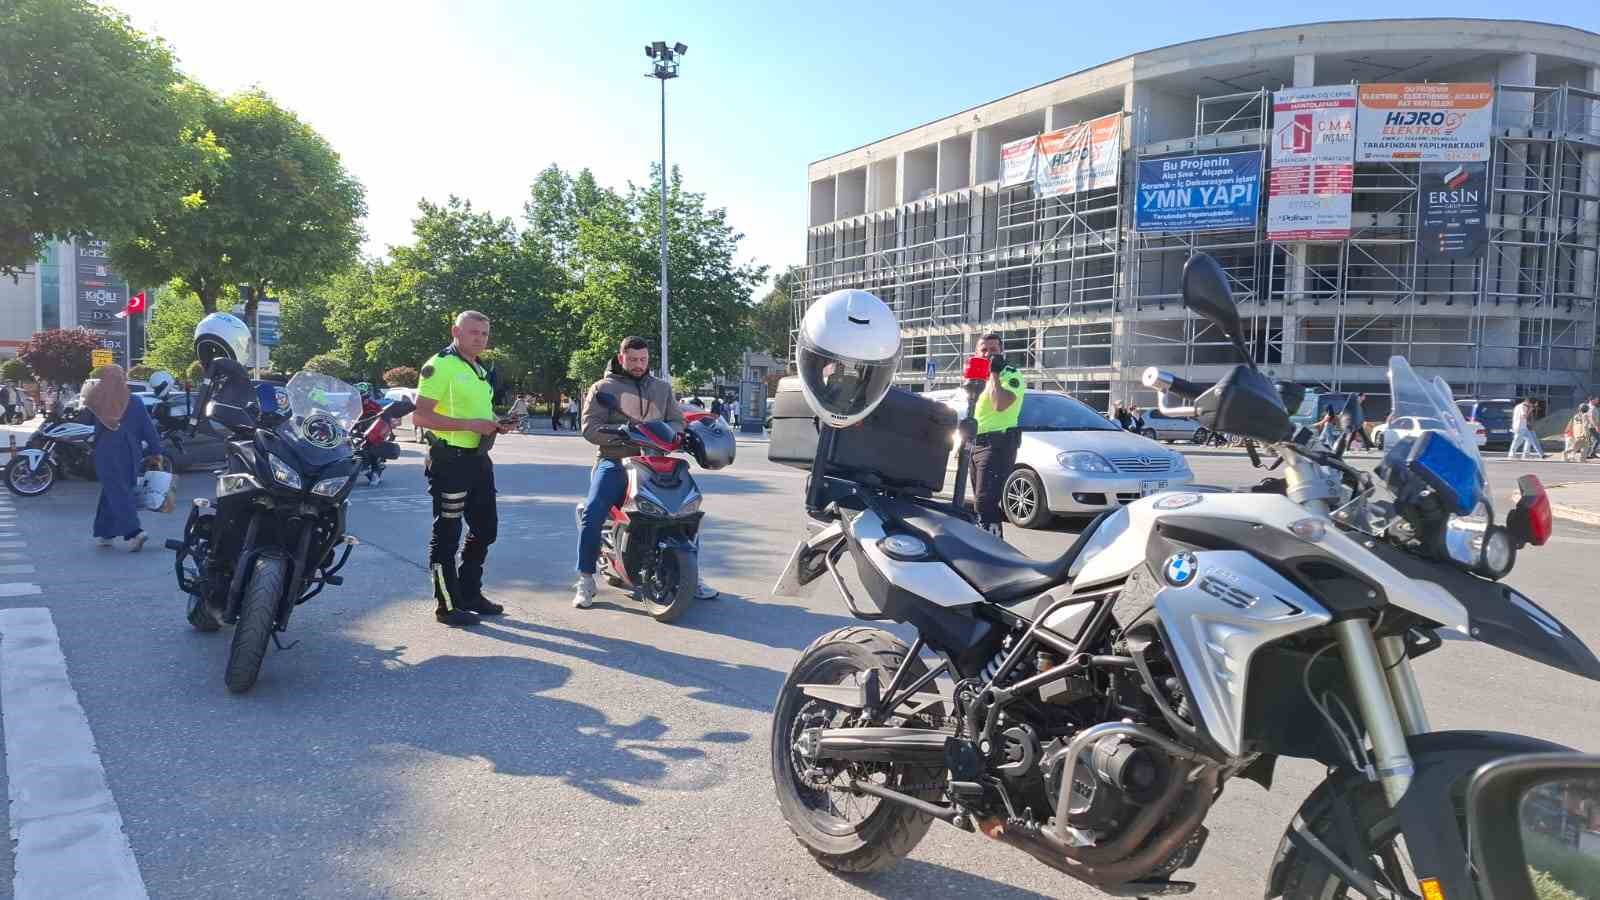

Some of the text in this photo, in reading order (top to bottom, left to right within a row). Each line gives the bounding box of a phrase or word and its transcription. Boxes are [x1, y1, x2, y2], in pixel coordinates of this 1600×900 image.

[1162, 157, 1230, 171] Bu Projenin
[1143, 183, 1254, 209] YMN YAPI
[1429, 188, 1478, 203] ERSİN
